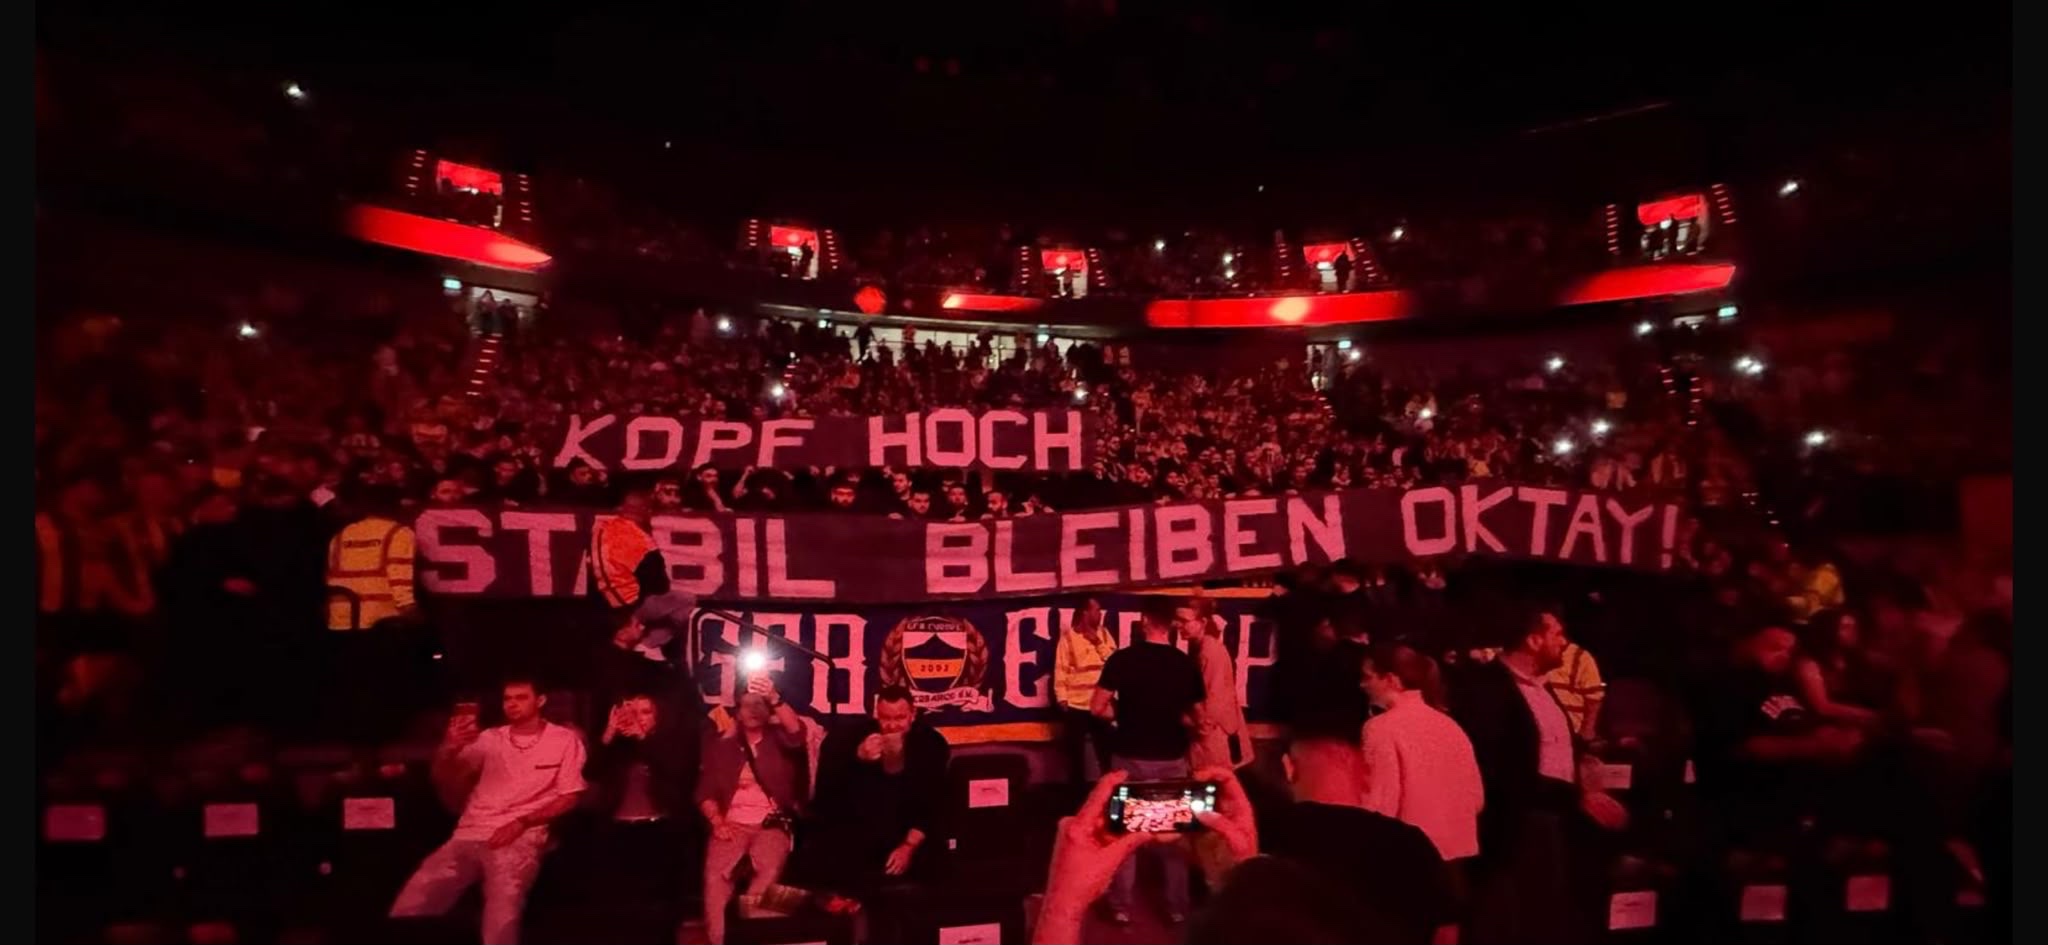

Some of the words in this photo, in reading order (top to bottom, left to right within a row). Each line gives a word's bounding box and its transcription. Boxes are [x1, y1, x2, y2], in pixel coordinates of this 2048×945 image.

[554, 414, 814, 470] KOPF
[868, 409, 1082, 469] HOCH
[414, 508, 836, 598] STBIL
[925, 494, 1347, 594] BLEIBEN
[1401, 485, 1677, 569] OKTAY!
